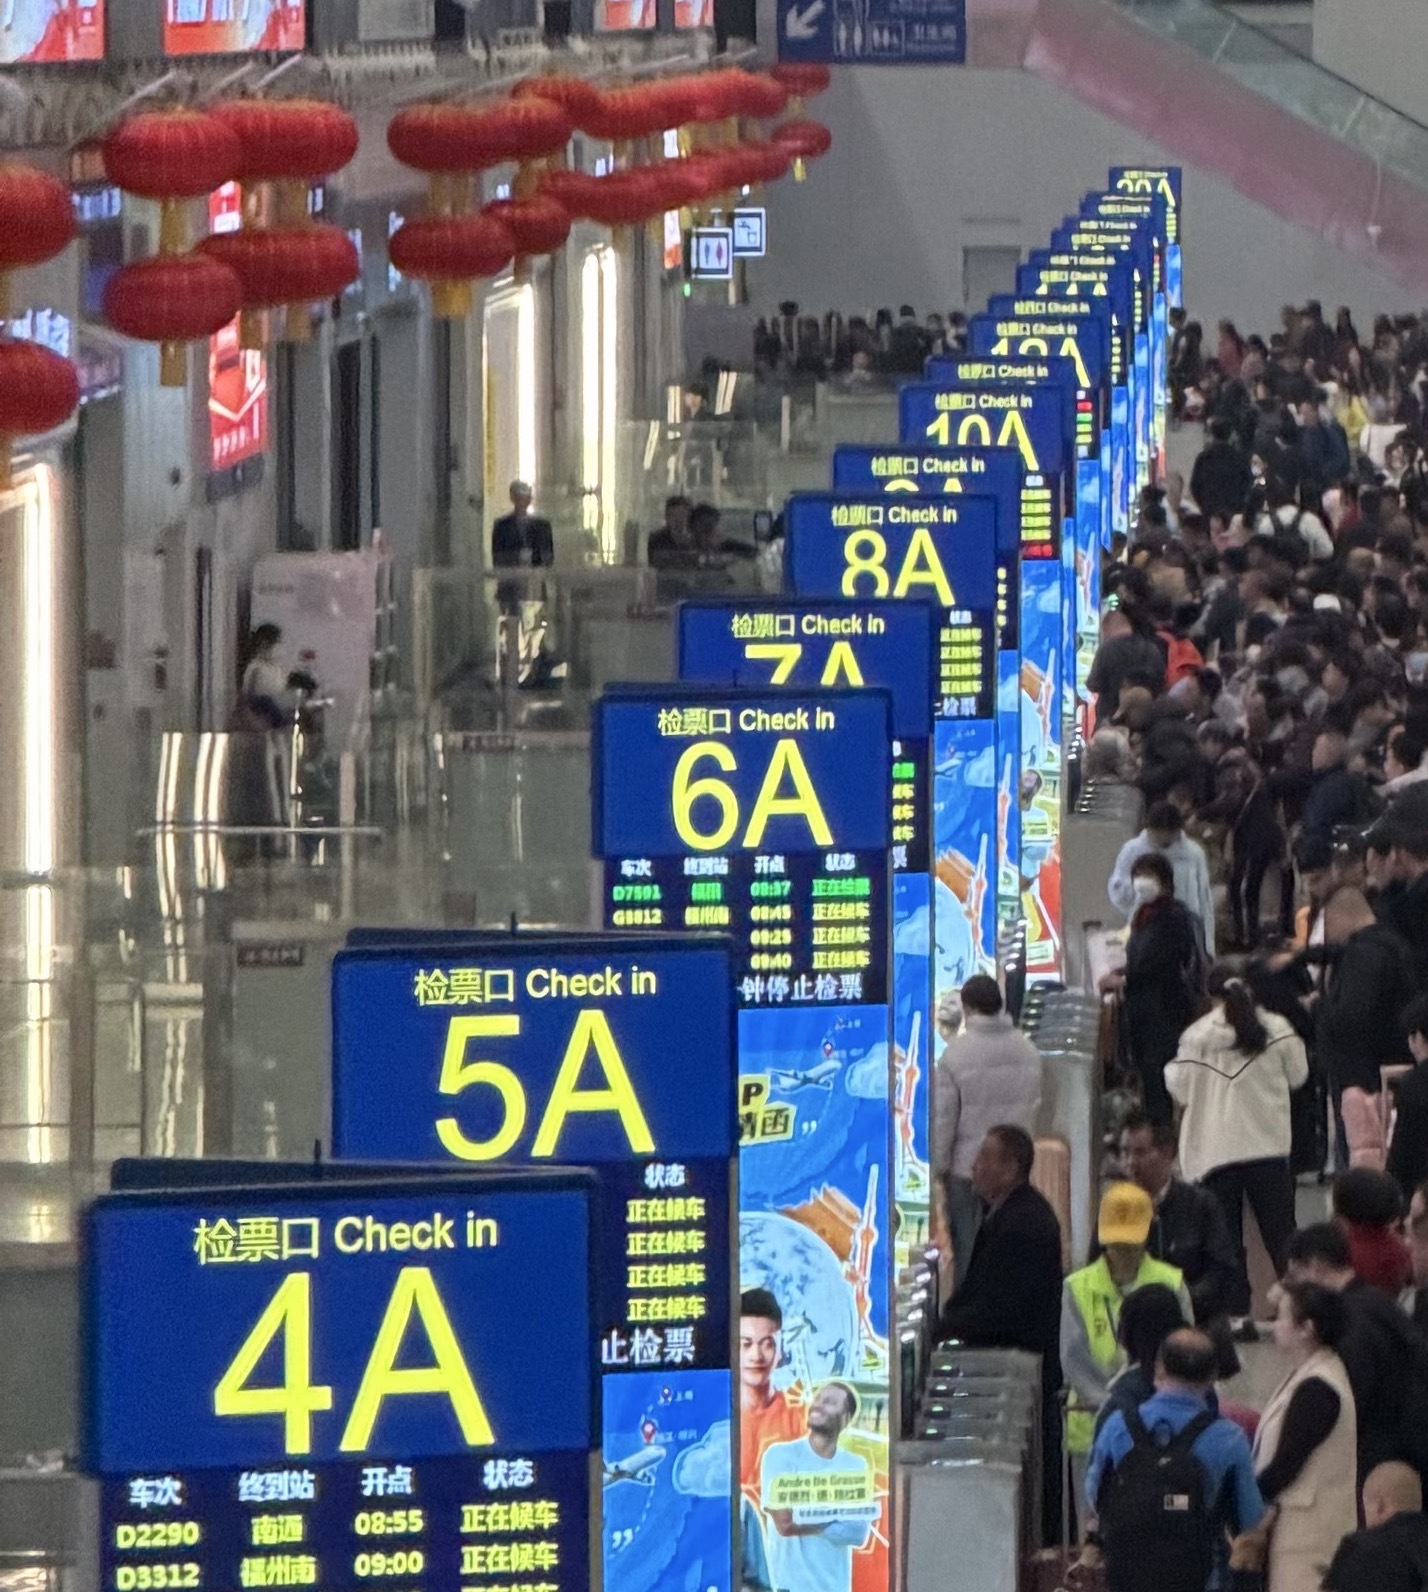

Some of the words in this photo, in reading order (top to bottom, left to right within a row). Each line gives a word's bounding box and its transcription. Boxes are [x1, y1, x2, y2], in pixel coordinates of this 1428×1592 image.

[979, 395, 1017, 408] Check
[923, 458, 967, 473] Check
[972, 457, 985, 472] in
[888, 507, 938, 523] Check
[943, 506, 957, 522] in
[842, 528, 955, 606] 8A
[801, 615, 862, 635] Check
[868, 614, 885, 633] in
[657, 707, 732, 736] 检票口
[738, 709, 809, 732] Check
[815, 707, 835, 730] in
[671, 738, 834, 850] 6A
[413, 967, 514, 1006] 检票口
[525, 969, 622, 999] Check
[630, 966, 656, 995] in
[435, 1008, 656, 1162] 5A
[626, 1196, 706, 1223] 正在候车
[193, 1216, 320, 1266] 检票口
[334, 1212, 455, 1254] Check
[466, 1210, 498, 1248] in
[626, 1230, 706, 1255] 正在候车
[626, 1263, 706, 1288] 正在候车
[626, 1296, 706, 1321] 正在候车
[214, 1265, 496, 1454] 4A
[129, 1477, 182, 1508] 车次
[239, 1471, 315, 1502] 终到站
[361, 1467, 413, 1497] 开点
[484, 1460, 534, 1490] 状态
[116, 1520, 199, 1549] D2290
[251, 1515, 304, 1546] 南通
[354, 1509, 424, 1535] 08:55
[460, 1501, 560, 1533] 正在候车
[116, 1563, 199, 1591] D3312
[241, 1556, 316, 1588] 福州南
[354, 1551, 424, 1576] 09:00
[460, 1542, 560, 1574] 正在候车
